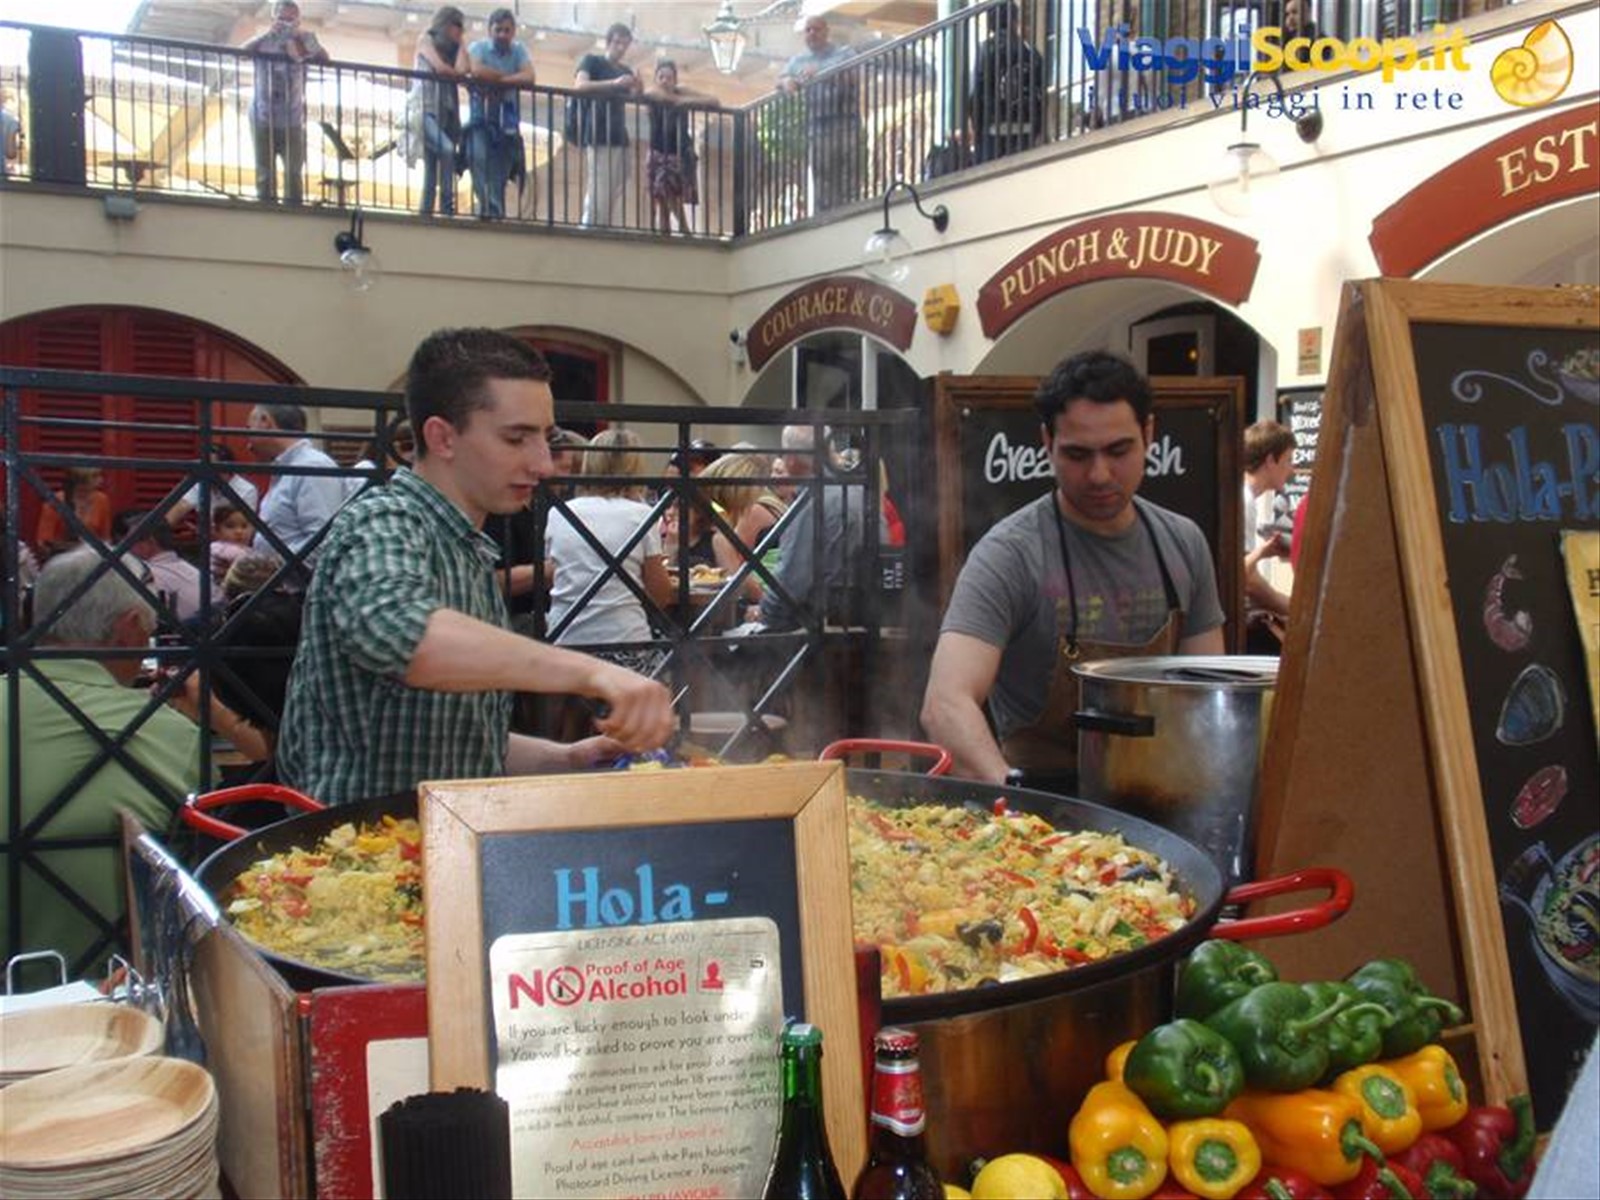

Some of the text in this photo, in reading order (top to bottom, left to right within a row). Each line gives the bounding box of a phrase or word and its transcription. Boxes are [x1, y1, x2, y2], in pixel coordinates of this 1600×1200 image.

[1000, 225, 1224, 311] PUNCH & JUDY
[762, 286, 849, 346] COURAGE
[850, 288, 866, 316] &
[984, 431, 1055, 484] Grea
[1436, 423, 1600, 523] Hola-P
[586, 957, 686, 976] Proof of Age
[589, 973, 687, 1001] Alcohol
[522, 1028, 546, 1040] you
[550, 1025, 570, 1036] are
[574, 1017, 606, 1035] lucky
[612, 1013, 660, 1031] enough
[664, 1015, 677, 1026] to
[681, 1010, 708, 1024] look
[510, 1046, 536, 1061] You
[585, 1038, 619, 1055] asked
[623, 1040, 636, 1052] to
[640, 1038, 675, 1052] prove
[680, 1036, 701, 1050] you
[705, 1035, 722, 1045] are
[727, 1033, 753, 1043] over
[544, 1158, 573, 1175] Proof
[575, 1157, 587, 1172] of
[555, 1175, 610, 1190] Photocard
[613, 1170, 648, 1186] Driving
